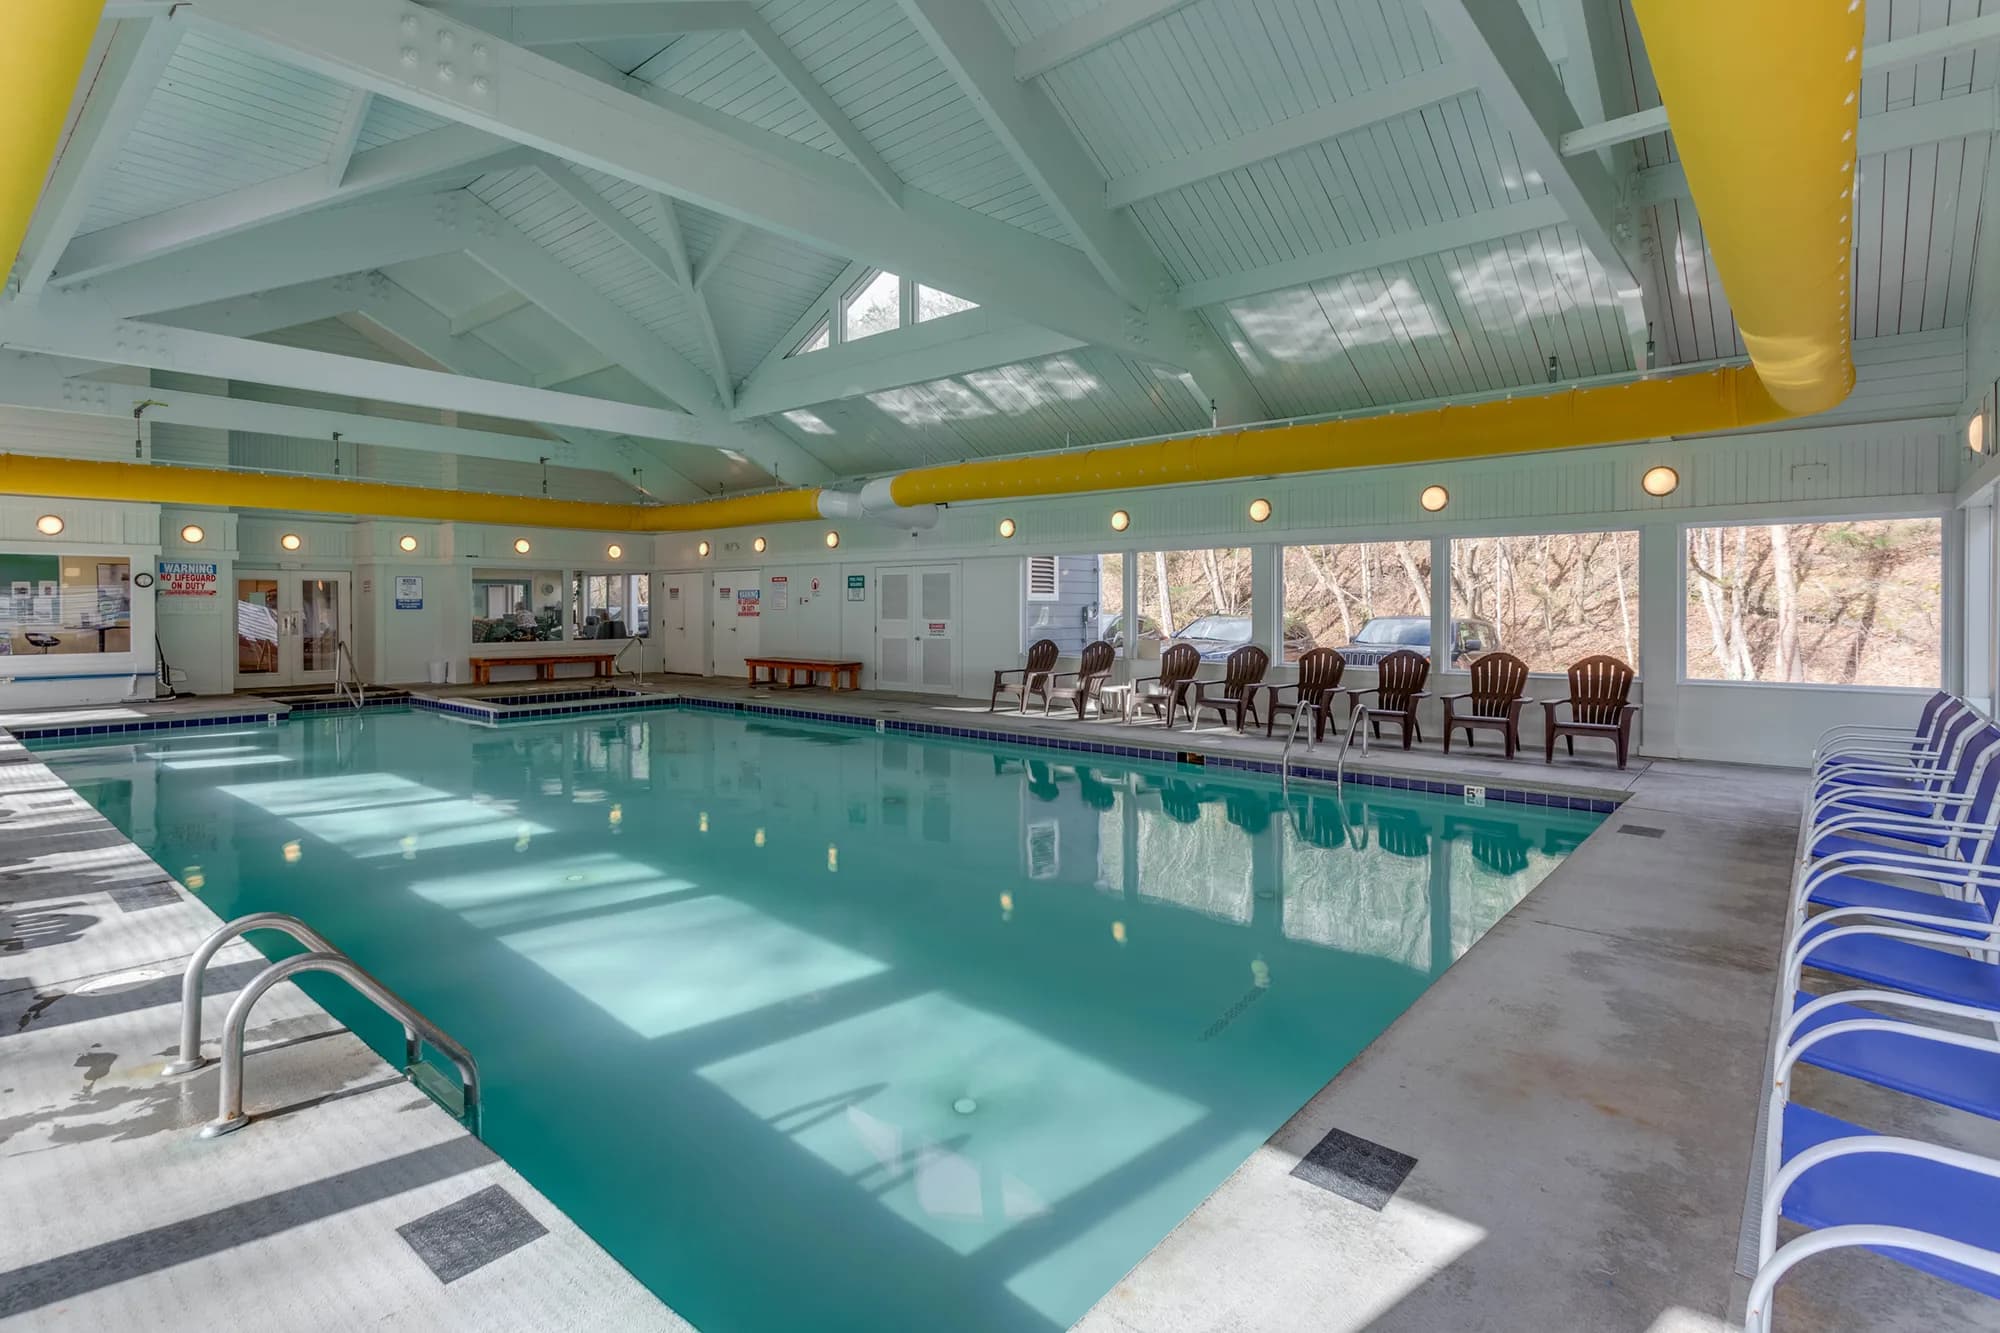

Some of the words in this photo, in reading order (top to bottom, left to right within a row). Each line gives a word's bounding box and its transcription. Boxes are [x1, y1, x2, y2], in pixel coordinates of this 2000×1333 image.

[163, 563, 213, 573] WARNING
[175, 574, 216, 582] LIFEGUARD
[1466, 787, 1476, 798] 5
